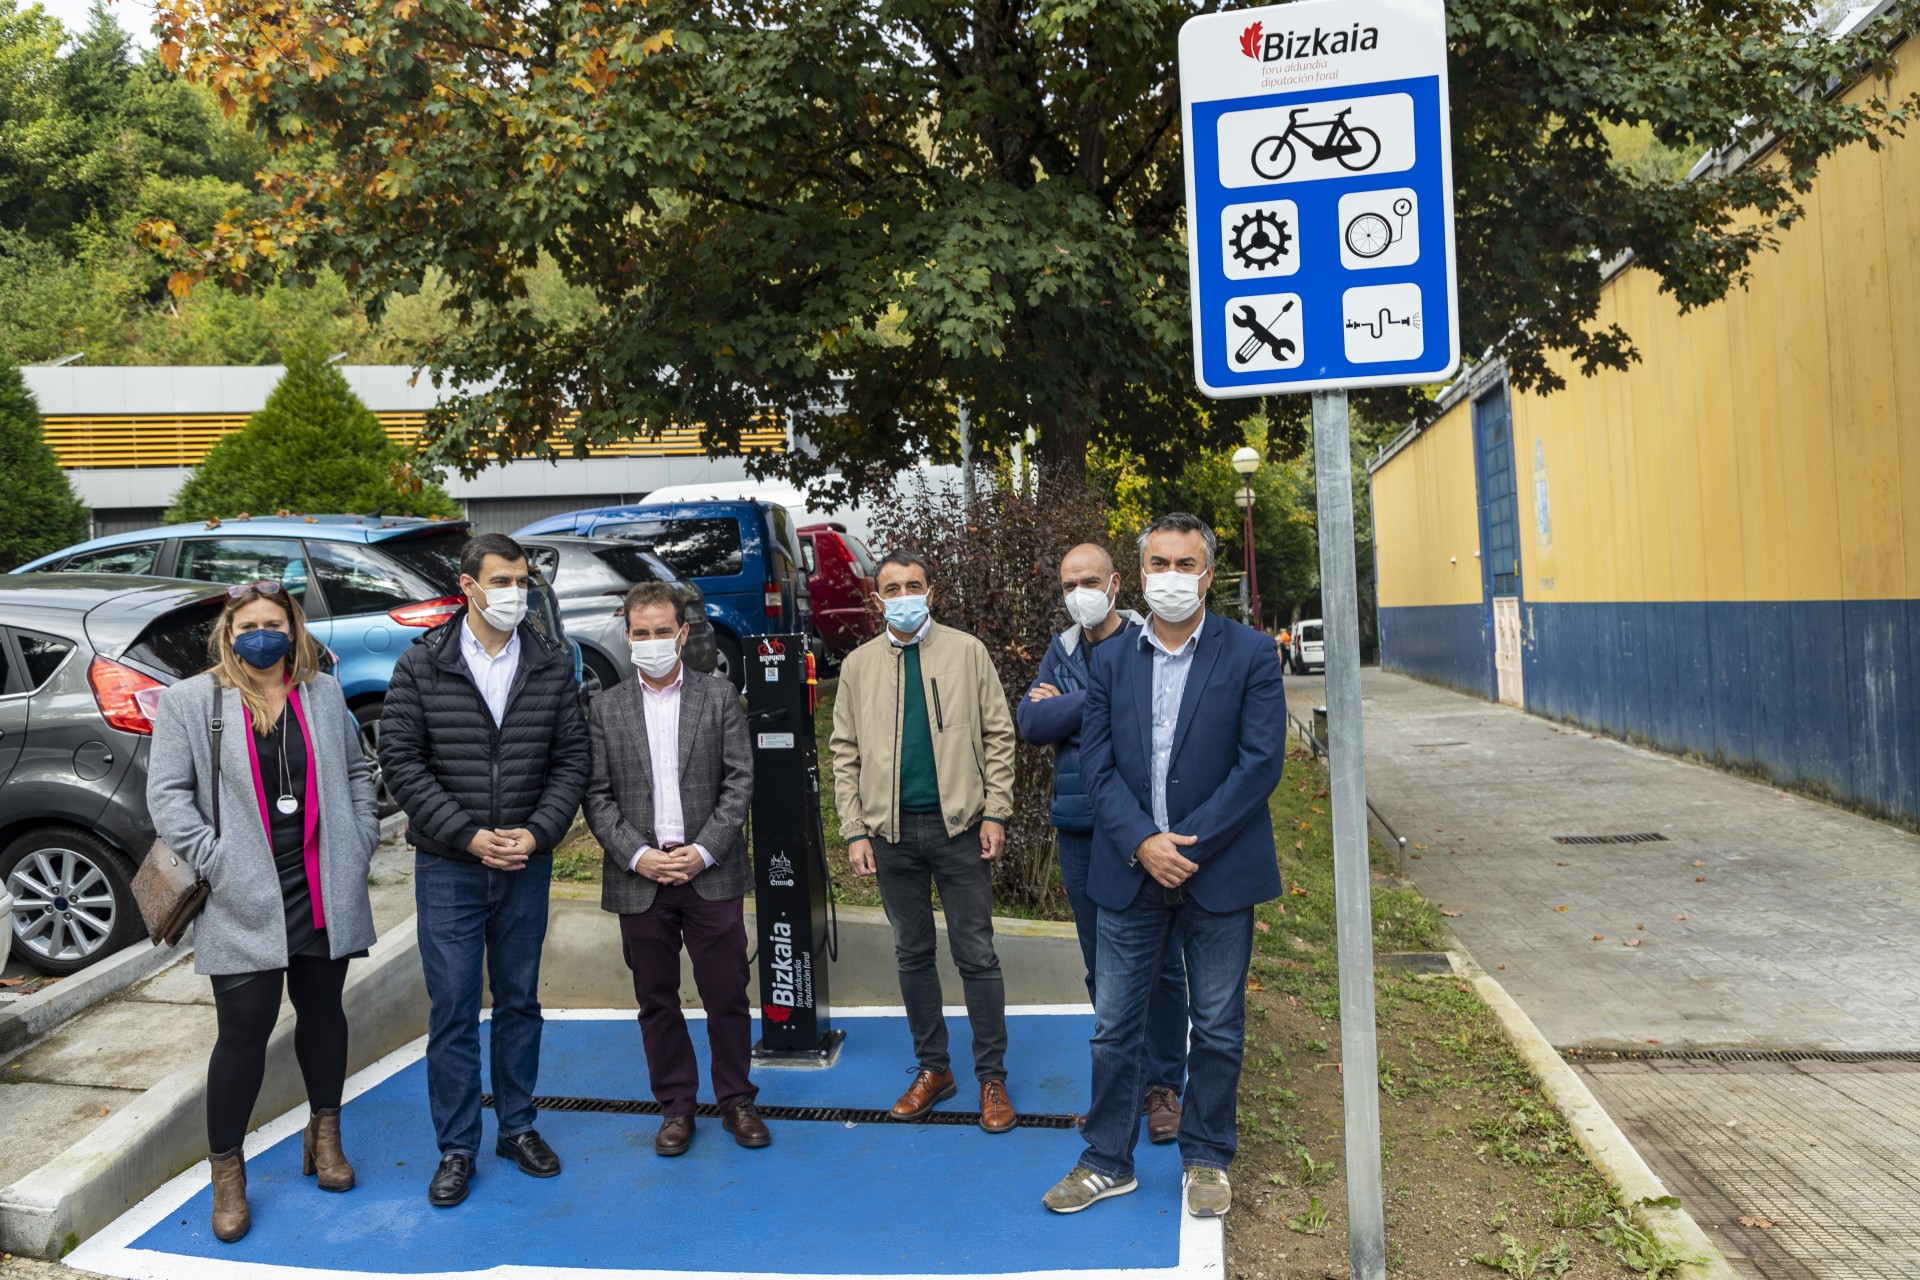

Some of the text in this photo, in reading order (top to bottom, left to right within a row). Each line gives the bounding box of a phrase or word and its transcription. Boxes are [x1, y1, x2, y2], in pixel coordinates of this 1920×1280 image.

[1263, 22, 1379, 62] Bizkaia
[1261, 69, 1339, 88] diputación foral
[1262, 59, 1327, 76] foru aldundia
[770, 922, 794, 1007] Bizkaia
[794, 959, 804, 1008] foru aldundia
[802, 952, 813, 1008] diputación foral
